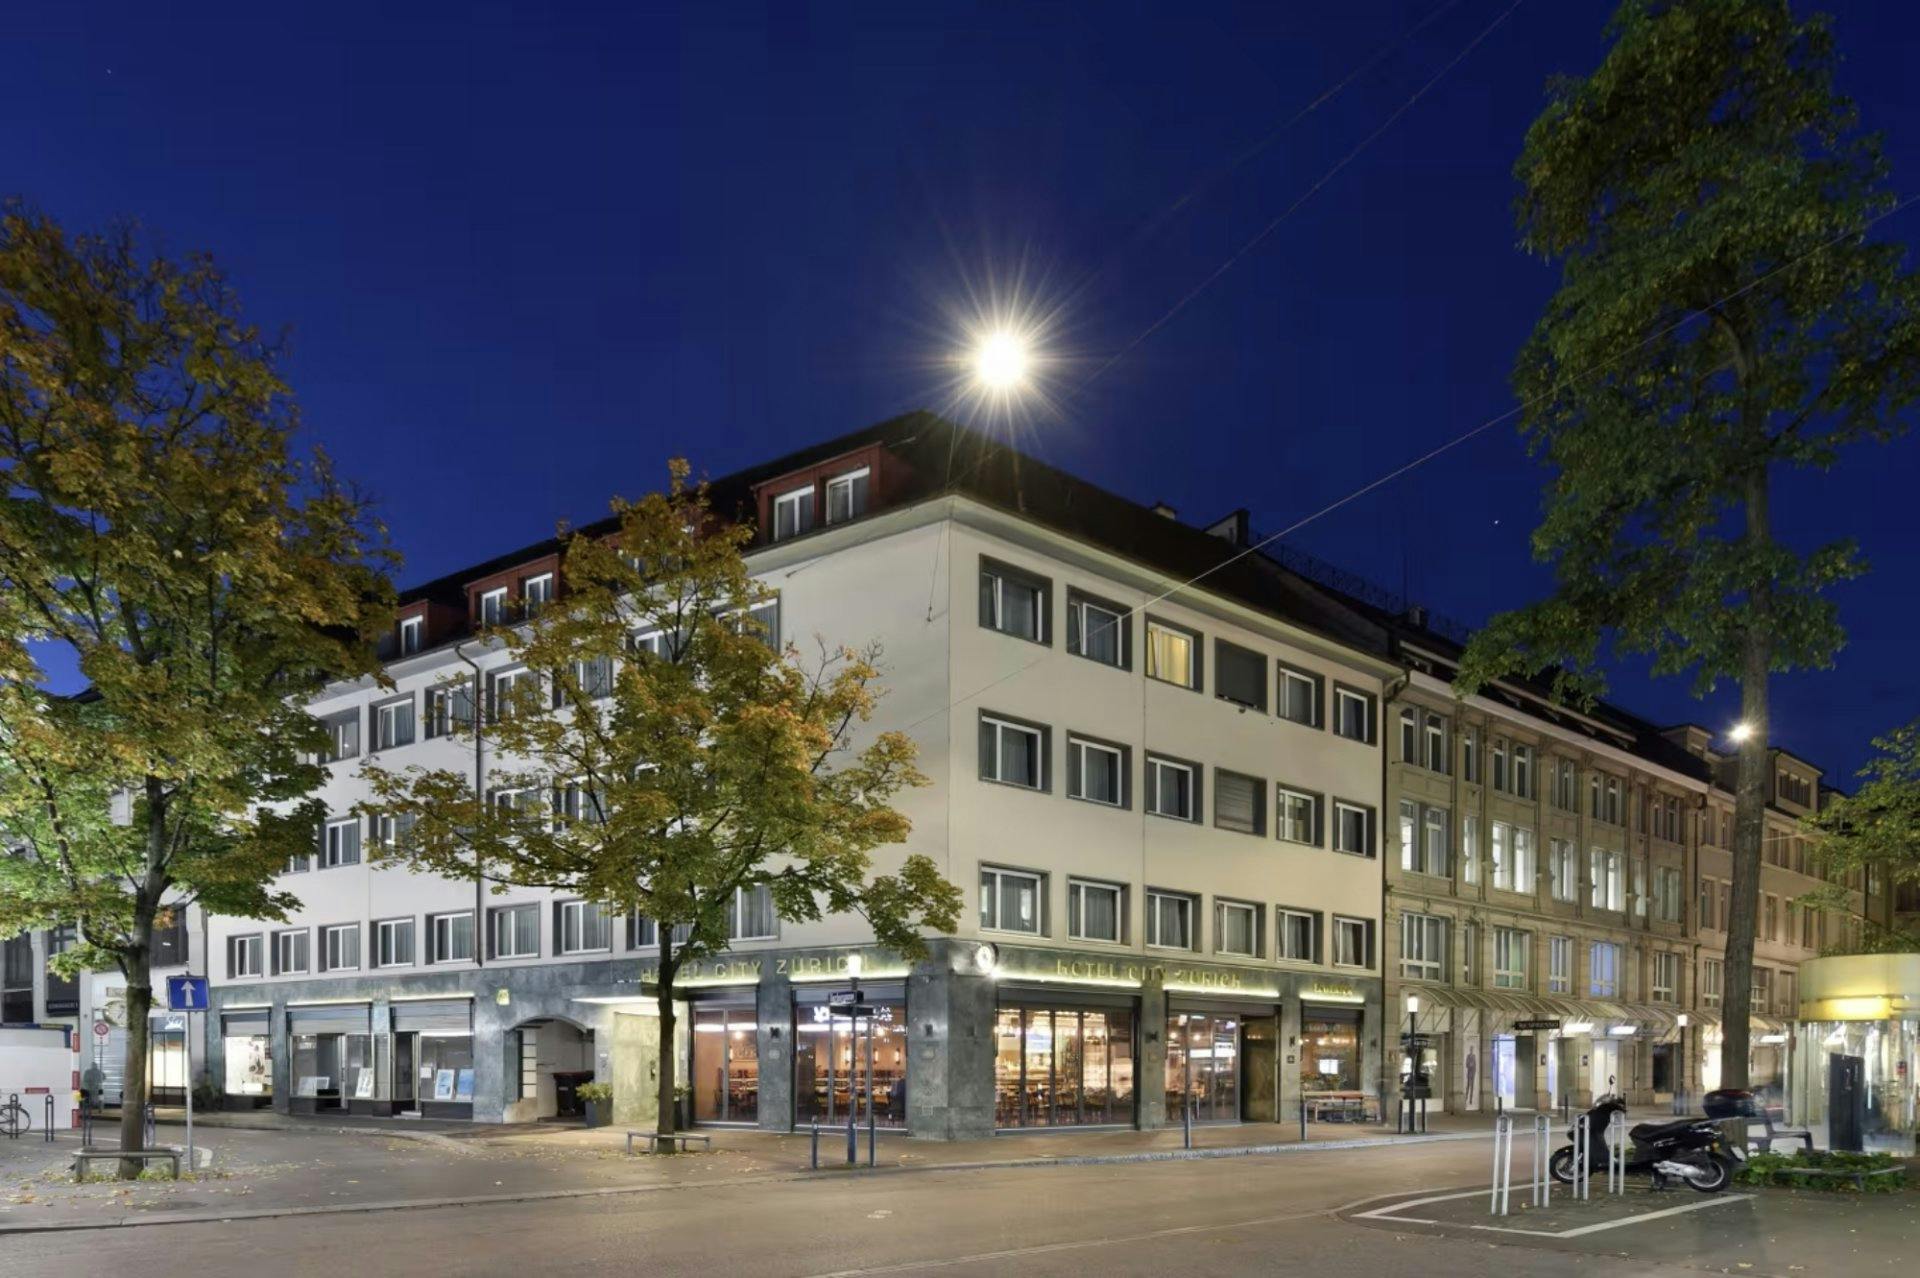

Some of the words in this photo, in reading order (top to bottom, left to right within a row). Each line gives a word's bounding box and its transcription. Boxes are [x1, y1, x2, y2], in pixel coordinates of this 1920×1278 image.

[641, 960, 703, 982] HEL
[715, 961, 762, 979] CITY
[1057, 959, 1118, 979] HOTEL
